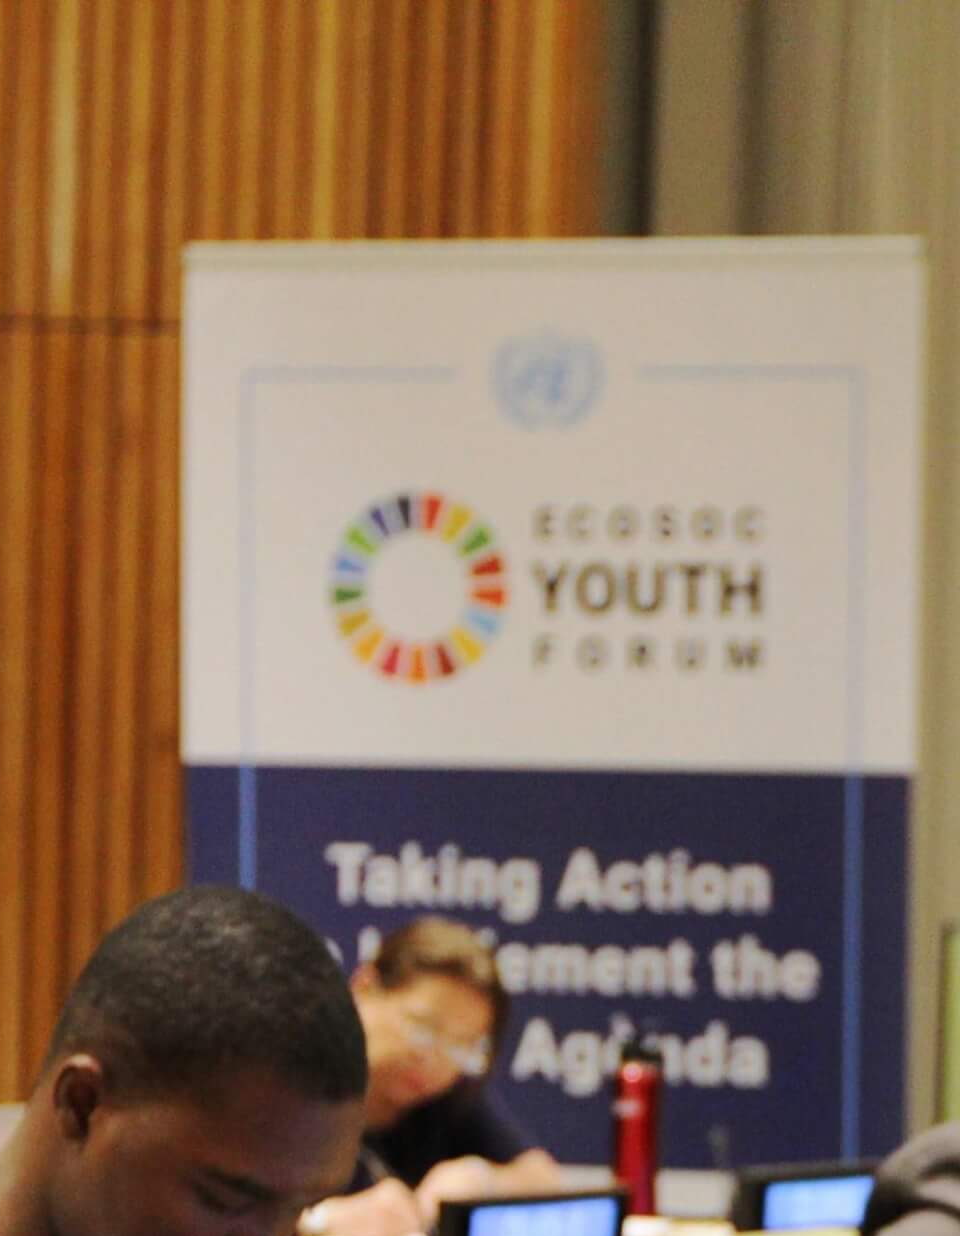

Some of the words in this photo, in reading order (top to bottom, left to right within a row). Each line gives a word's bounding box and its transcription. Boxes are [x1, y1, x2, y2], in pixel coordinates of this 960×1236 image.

[533, 506, 765, 541] ECOSOC
[533, 561, 762, 615] YOUTH
[534, 638, 763, 670] FORUM
[326, 842, 540, 922] Taking
[558, 848, 772, 913] Action
[712, 935, 820, 1000] the
